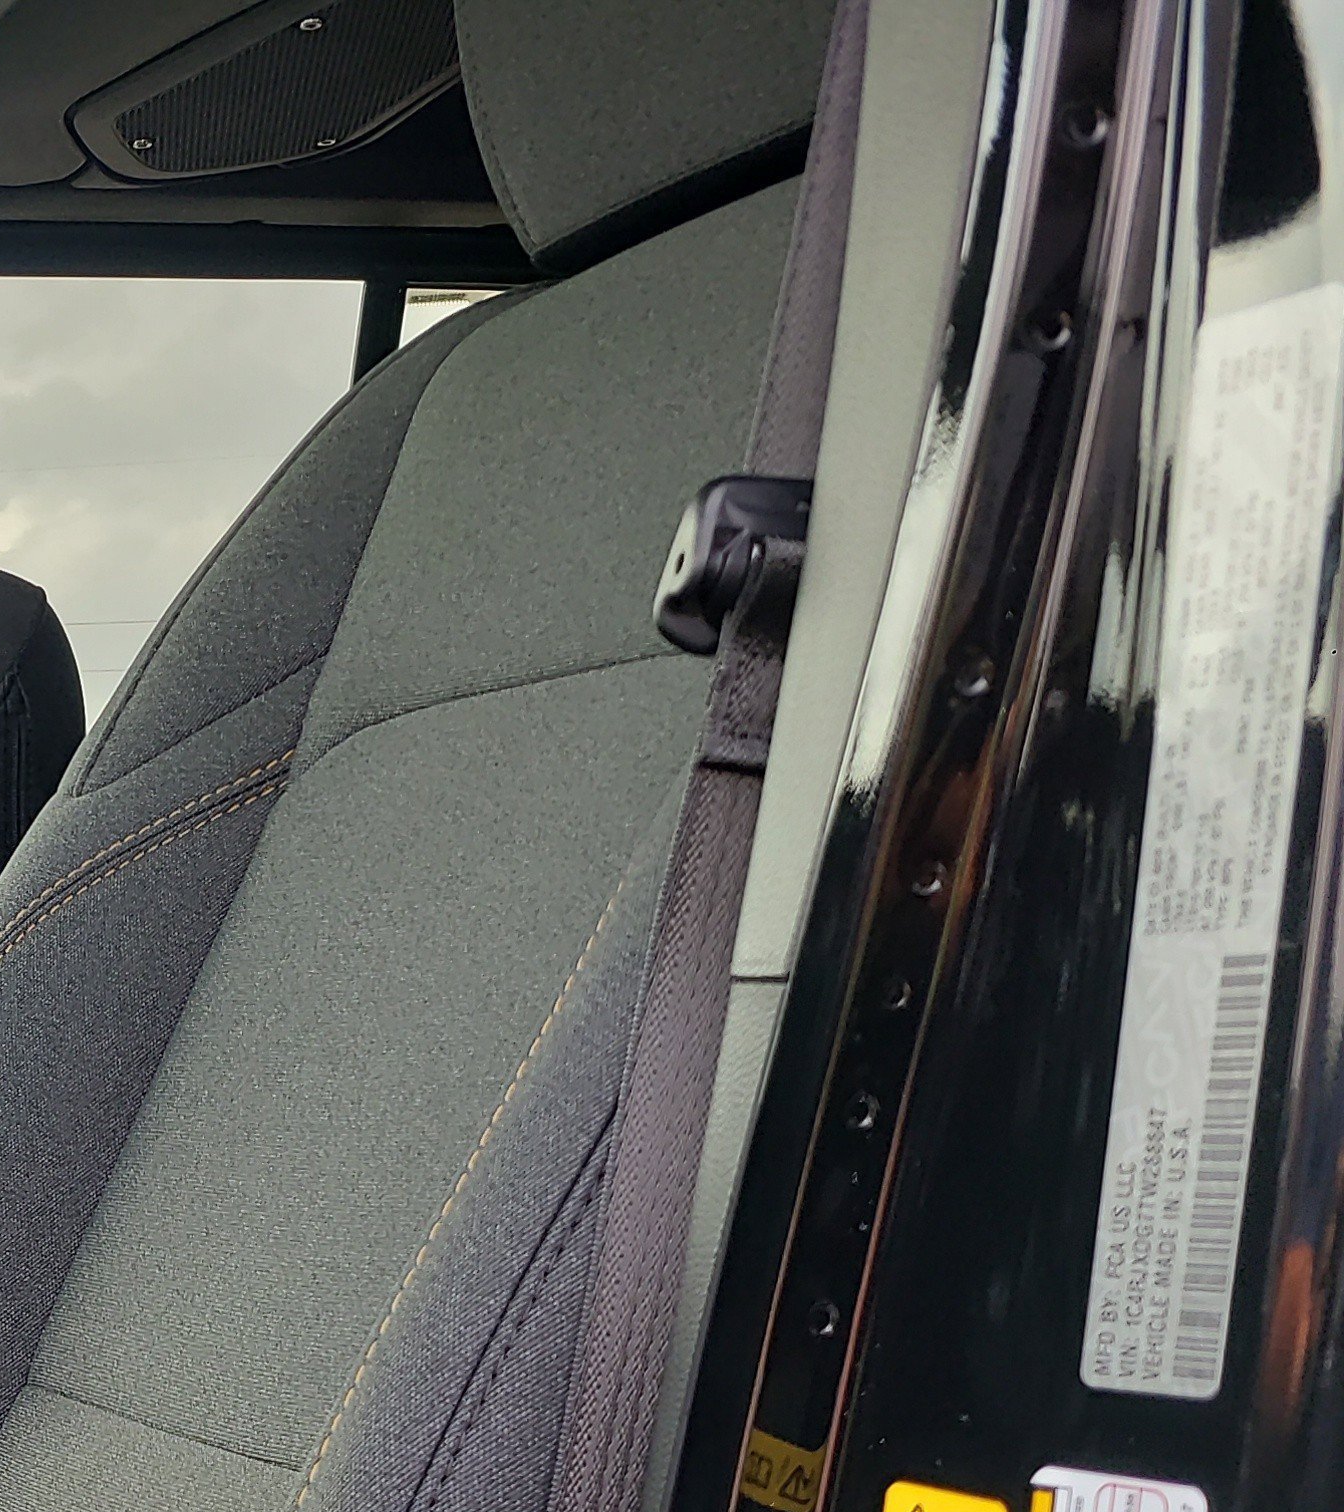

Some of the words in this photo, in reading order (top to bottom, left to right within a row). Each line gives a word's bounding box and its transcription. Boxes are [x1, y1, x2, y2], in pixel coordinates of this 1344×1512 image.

[1115, 1160, 1136, 1199] LLC
[1109, 1205, 1131, 1234] US
[1152, 1226, 1179, 1288] MADE
[1142, 1295, 1170, 1381] VEHICLE
